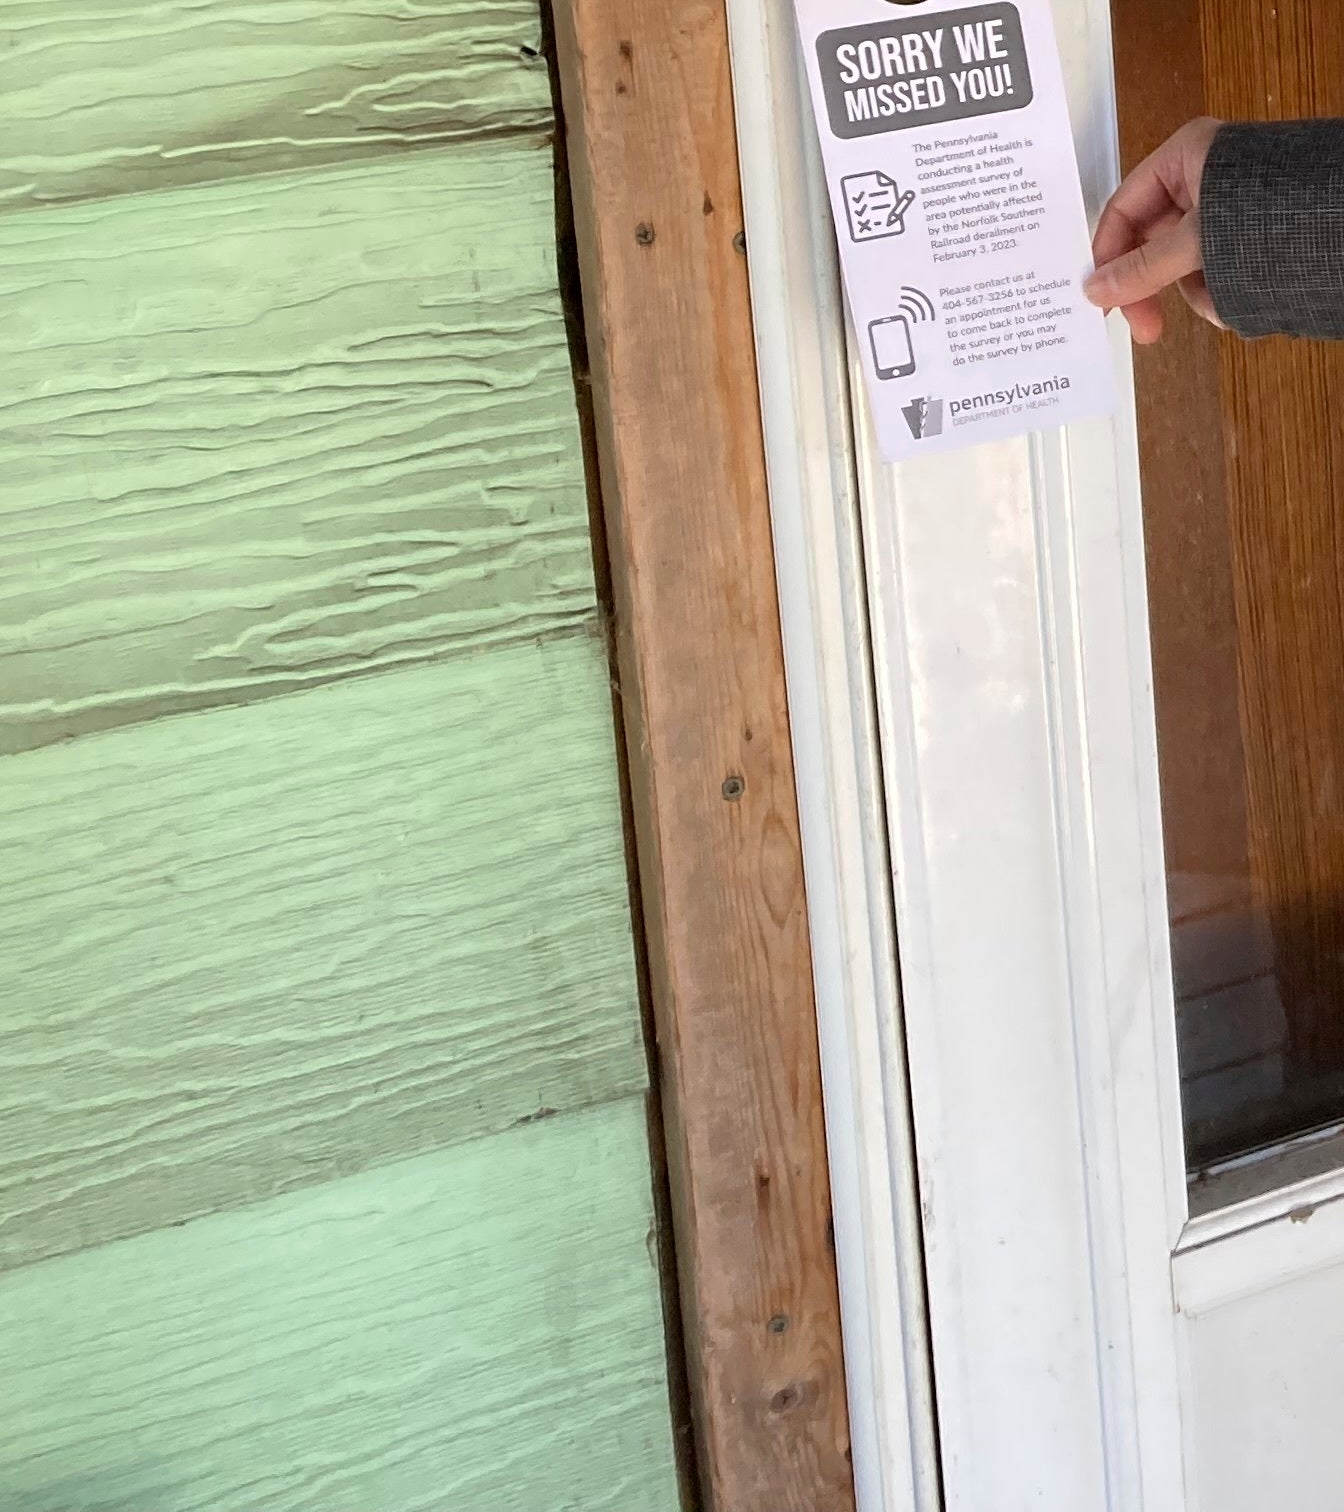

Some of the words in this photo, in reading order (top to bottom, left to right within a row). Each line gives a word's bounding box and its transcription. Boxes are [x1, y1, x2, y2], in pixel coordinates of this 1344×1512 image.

[836, 28, 944, 84] SORRY
[952, 18, 1008, 64] WE
[843, 75, 946, 123] MISSED
[949, 63, 1014, 103] YOU!
[912, 143, 932, 153] The
[934, 131, 999, 150] Pennsylvania
[915, 149, 975, 167] Department
[977, 146, 987, 156] of
[989, 140, 1023, 153] Health
[1024, 138, 1033, 147] is
[917, 164, 974, 181] conducting
[983, 156, 1015, 168] health
[920, 177, 977, 194] assessment
[979, 171, 1011, 185] survey
[1013, 167, 1024, 177] of
[922, 194, 957, 210] people
[959, 190, 981, 201] who
[982, 185, 1007, 197] were
[1008, 183, 1019, 192] in
[1020, 179, 1037, 190] the
[925, 212, 947, 222] area
[949, 199, 1001, 220] potentially
[1003, 192, 1043, 208] affected
[927, 226, 941, 237] by
[942, 222, 959, 233] the
[961, 214, 1000, 229] Norfolk
[1000, 207, 1046, 223] Southern
[930, 234, 971, 250] Railroad
[973, 224, 1025, 242] derailment
[1026, 222, 1040, 231] on
[933, 246, 977, 264] February
[939, 284, 972, 298] Please
[973, 276, 1011, 291] contact
[1012, 273, 1024, 283] us
[1025, 271, 1036, 280] at
[1015, 287, 1027, 296] to
[1028, 277, 1072, 294] schedule
[944, 316, 957, 325] an
[959, 302, 1021, 323] appointment
[1023, 298, 1038, 309] for
[1039, 296, 1052, 306] us
[947, 329, 959, 339] to
[960, 324, 988, 337] come
[989, 317, 1013, 331] back
[1014, 316, 1026, 326] to
[1027, 306, 1073, 323] complete
[949, 342, 967, 353] the
[968, 335, 1001, 349] survey
[1003, 332, 1014, 342] or
[1016, 329, 1035, 341] you
[1036, 323, 1057, 335] may
[952, 356, 966, 367] do
[967, 352, 985, 364] the
[986, 345, 1019, 360] survey
[1020, 342, 1033, 354] by
[949, 375, 1071, 417] pennsylvania
[952, 406, 1011, 427] DEPARTMENT
[1012, 404, 1024, 414] OF
[1025, 396, 1060, 410] HEALTH
